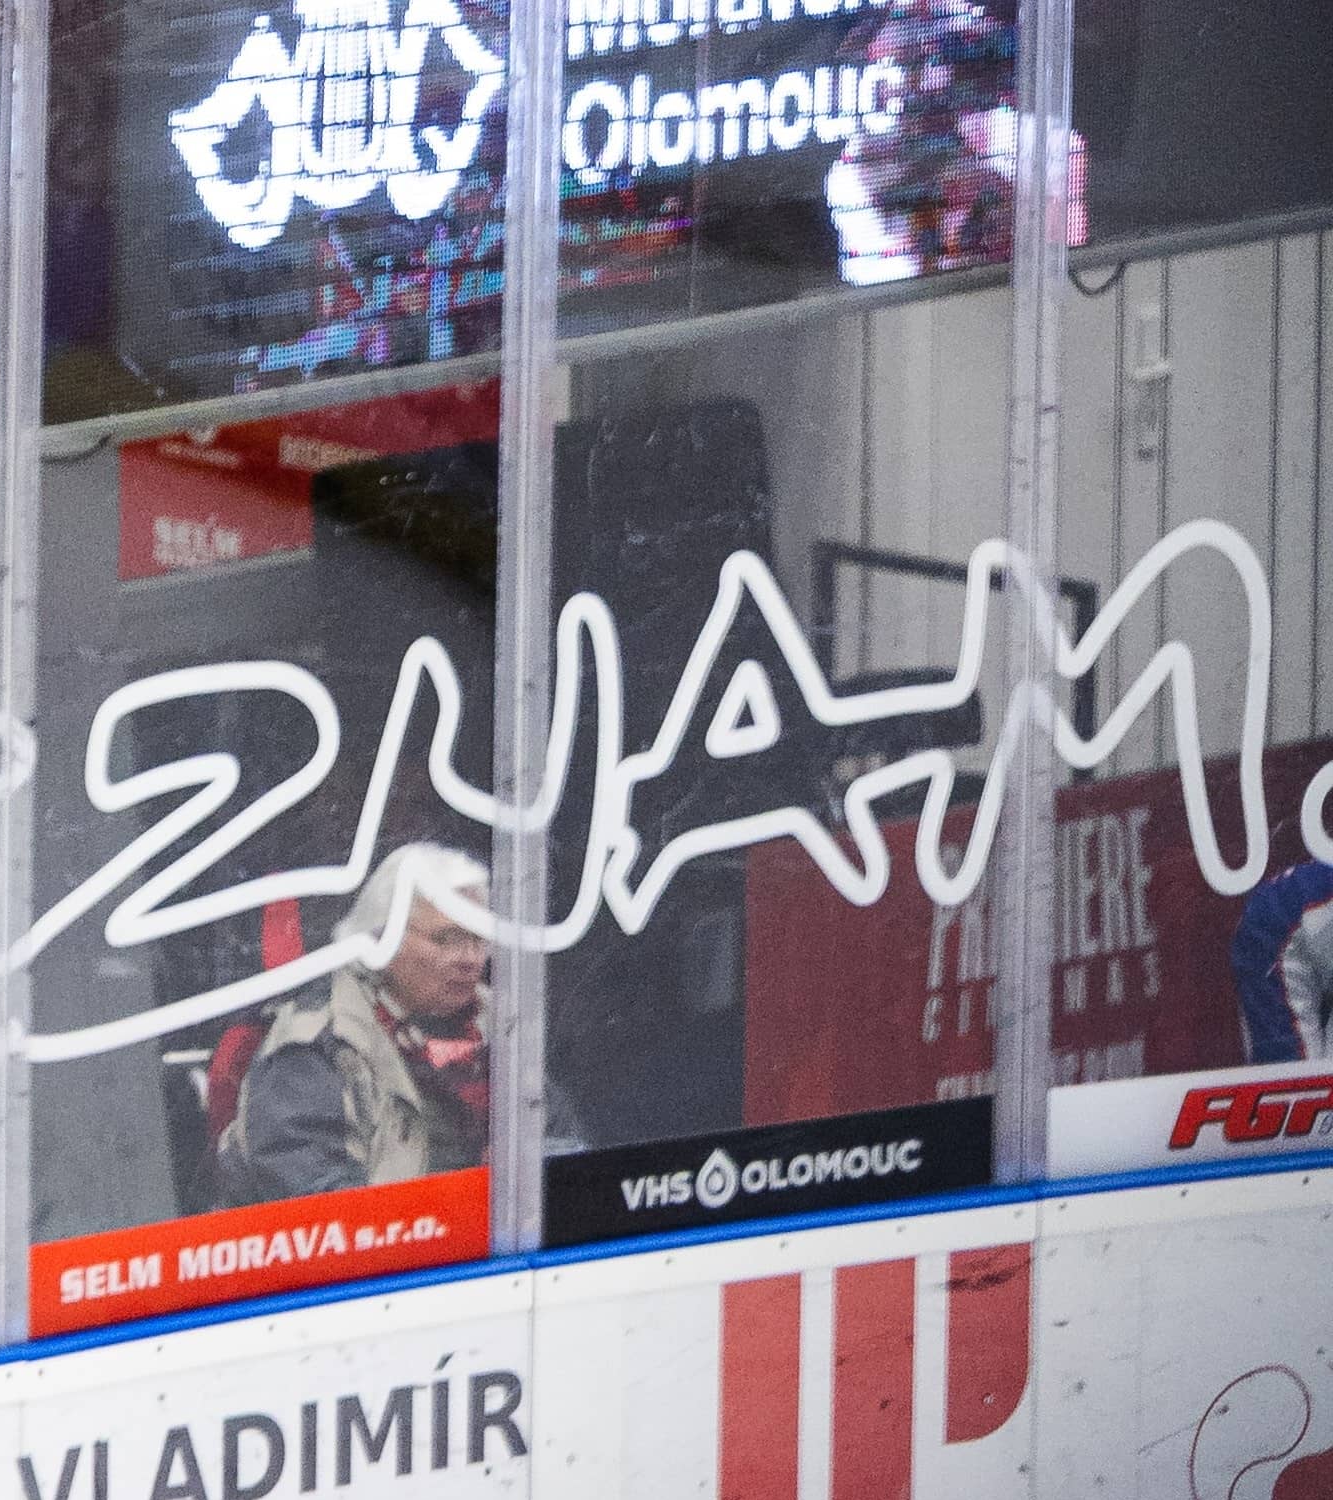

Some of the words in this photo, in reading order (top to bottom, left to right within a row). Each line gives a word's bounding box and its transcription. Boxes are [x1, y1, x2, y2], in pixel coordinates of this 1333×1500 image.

[563, 58, 906, 183] Olomouc
[621, 1169, 694, 1211] VHS
[741, 1138, 923, 1193] OLOMOUC
[60, 1254, 163, 1304] SELM
[177, 1221, 347, 1283] MORAVA
[354, 1215, 448, 1252] s.r.o.
